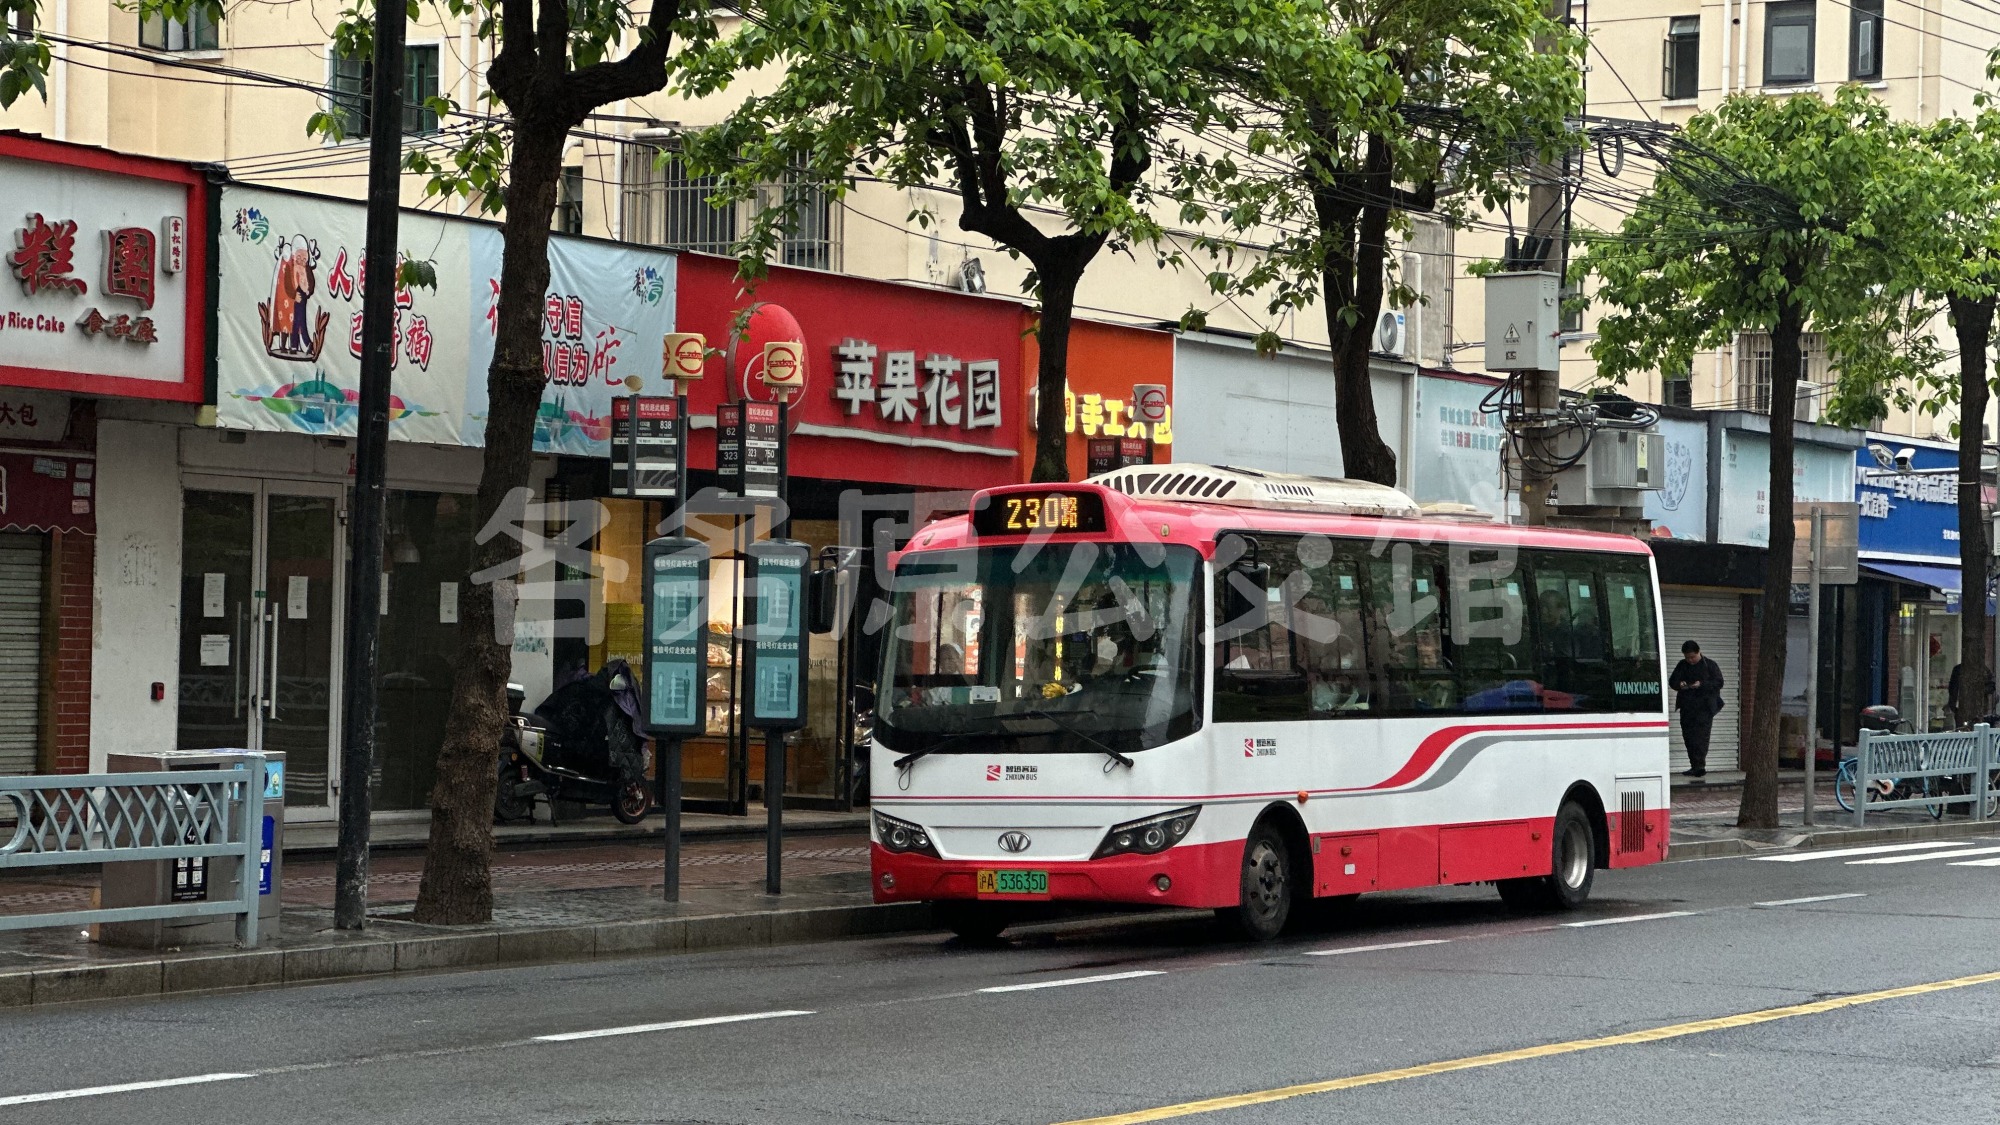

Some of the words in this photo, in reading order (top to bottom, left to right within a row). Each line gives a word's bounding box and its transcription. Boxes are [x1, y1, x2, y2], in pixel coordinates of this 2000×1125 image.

[10, 212, 156, 310] 糕團
[8, 311, 34, 330] Rice
[36, 314, 65, 334] Cake
[77, 307, 158, 343] 食品廠
[834, 336, 1002, 430] 苹果花园
[0, 401, 38, 427] 大包
[660, 420, 672, 431] 838
[748, 423, 757, 433] 62
[765, 424, 776, 434] 117
[726, 427, 736, 436] 62
[724, 451, 738, 460] 323
[747, 447, 757, 458] 323
[1095, 458, 1108, 466] 742
[1007, 497, 1078, 529] 230路
[652, 645, 697, 655] 看信号灯走安全路
[756, 641, 798, 651] 看信号灯走安全路
[1614, 681, 1660, 695] WANXIANG
[1026, 773, 1038, 781] BUS
